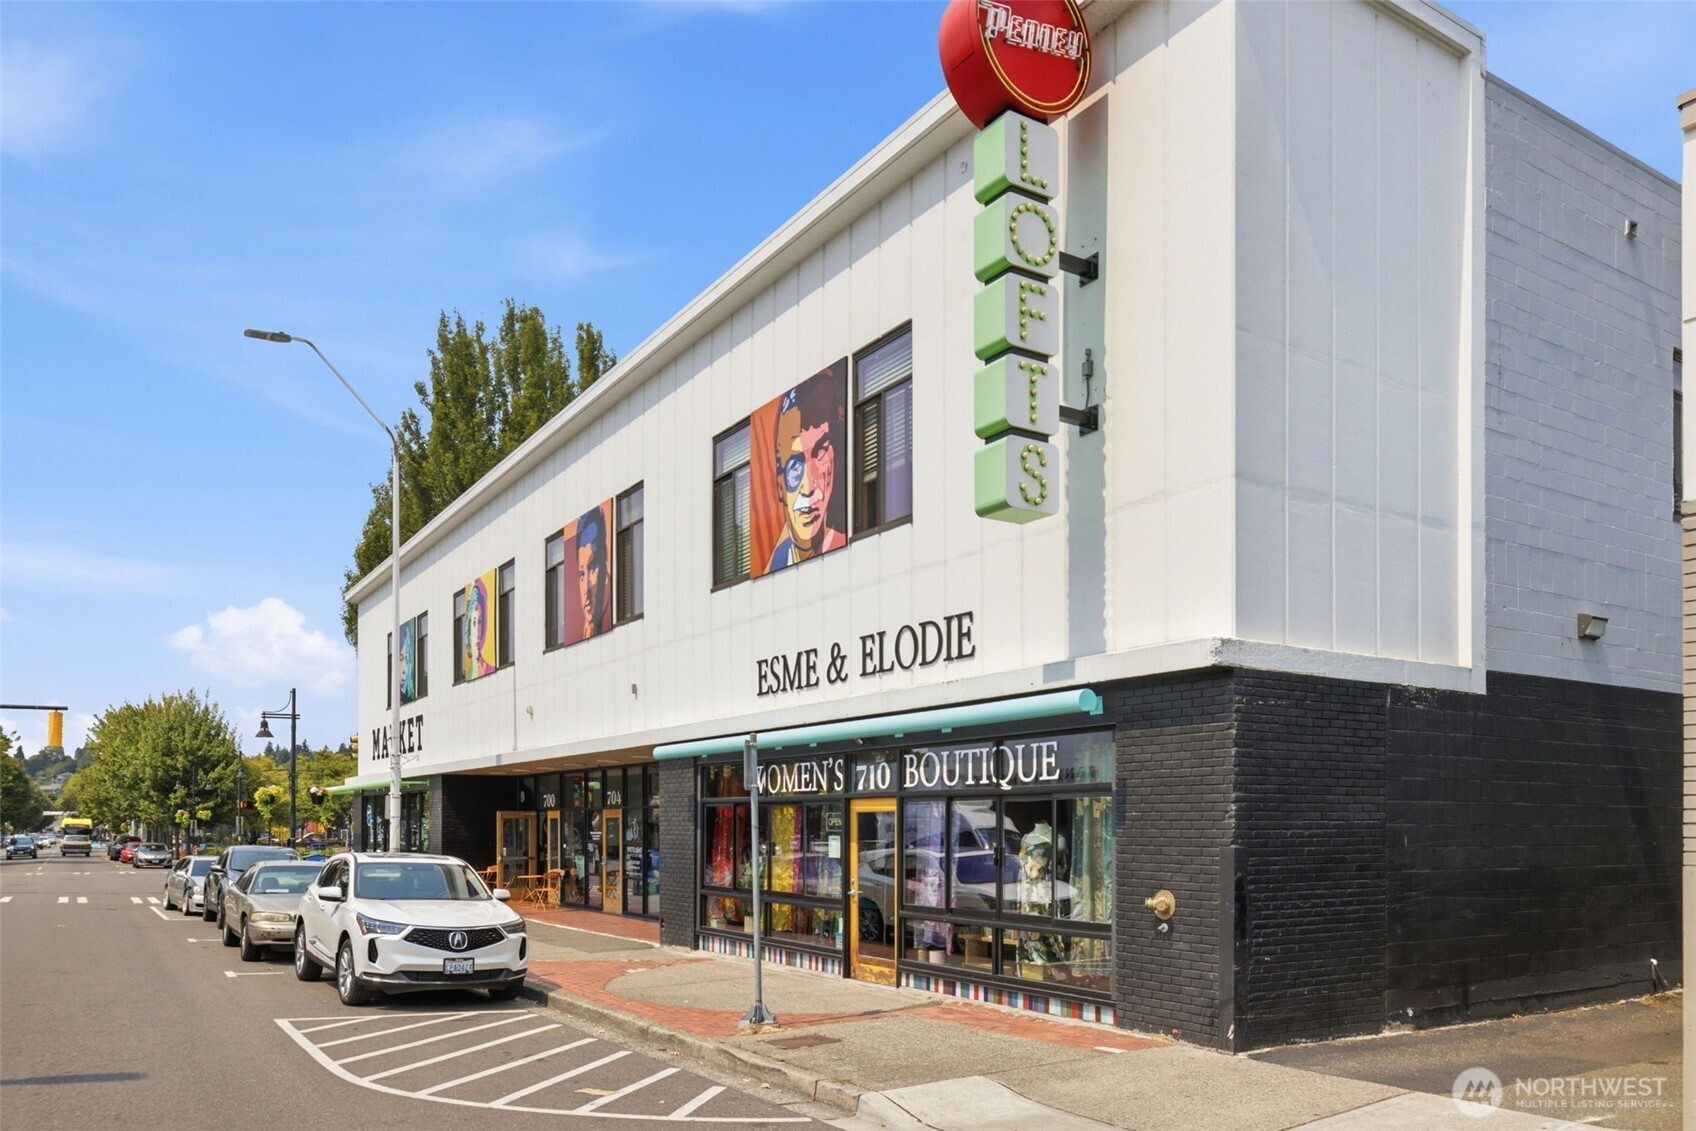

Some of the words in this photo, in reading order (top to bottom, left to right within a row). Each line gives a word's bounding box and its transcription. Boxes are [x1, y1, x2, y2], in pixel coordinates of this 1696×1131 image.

[1009, 119, 1057, 507] LOFTS
[756, 648, 819, 696] ESME
[826, 642, 848, 684] &
[859, 611, 976, 677] ELODIE
[372, 714, 424, 761] MAKET
[856, 762, 891, 790] 710
[903, 741, 1060, 790] BOUTIQUE
[543, 793, 556, 808] 700
[606, 790, 621, 805] 704
[828, 817, 842, 826] OPEN
